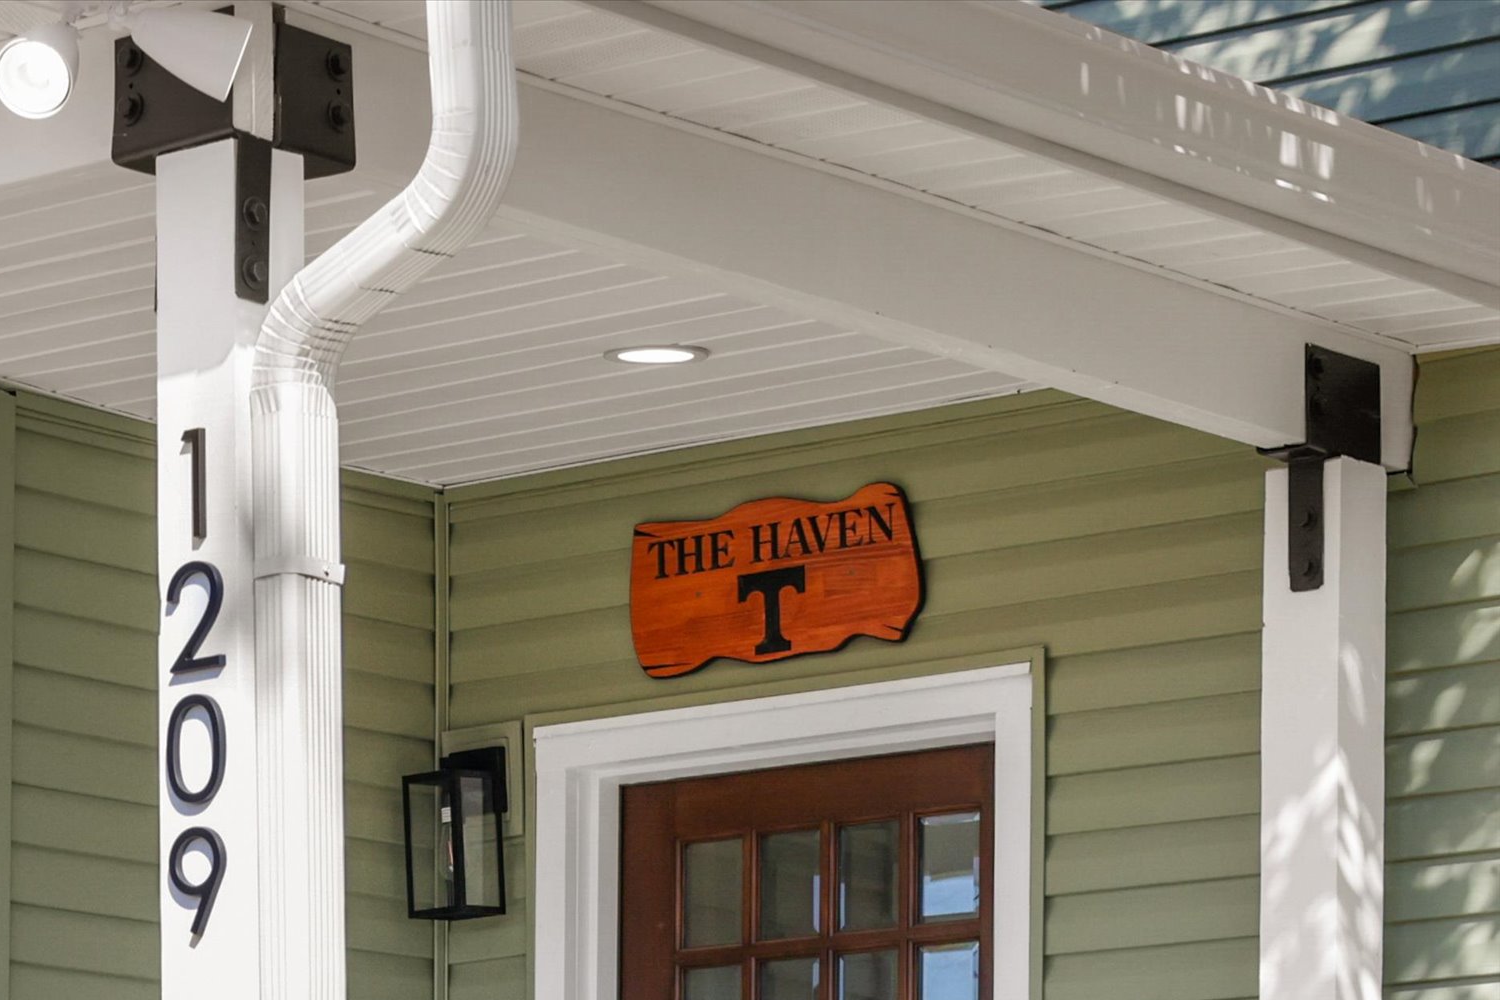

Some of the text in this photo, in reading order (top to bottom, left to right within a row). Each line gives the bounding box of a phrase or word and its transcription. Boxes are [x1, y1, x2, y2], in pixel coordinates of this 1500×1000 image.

[647, 502, 896, 580] THE HAVEN
[737, 564, 806, 656] T
[165, 426, 228, 938] 1209
